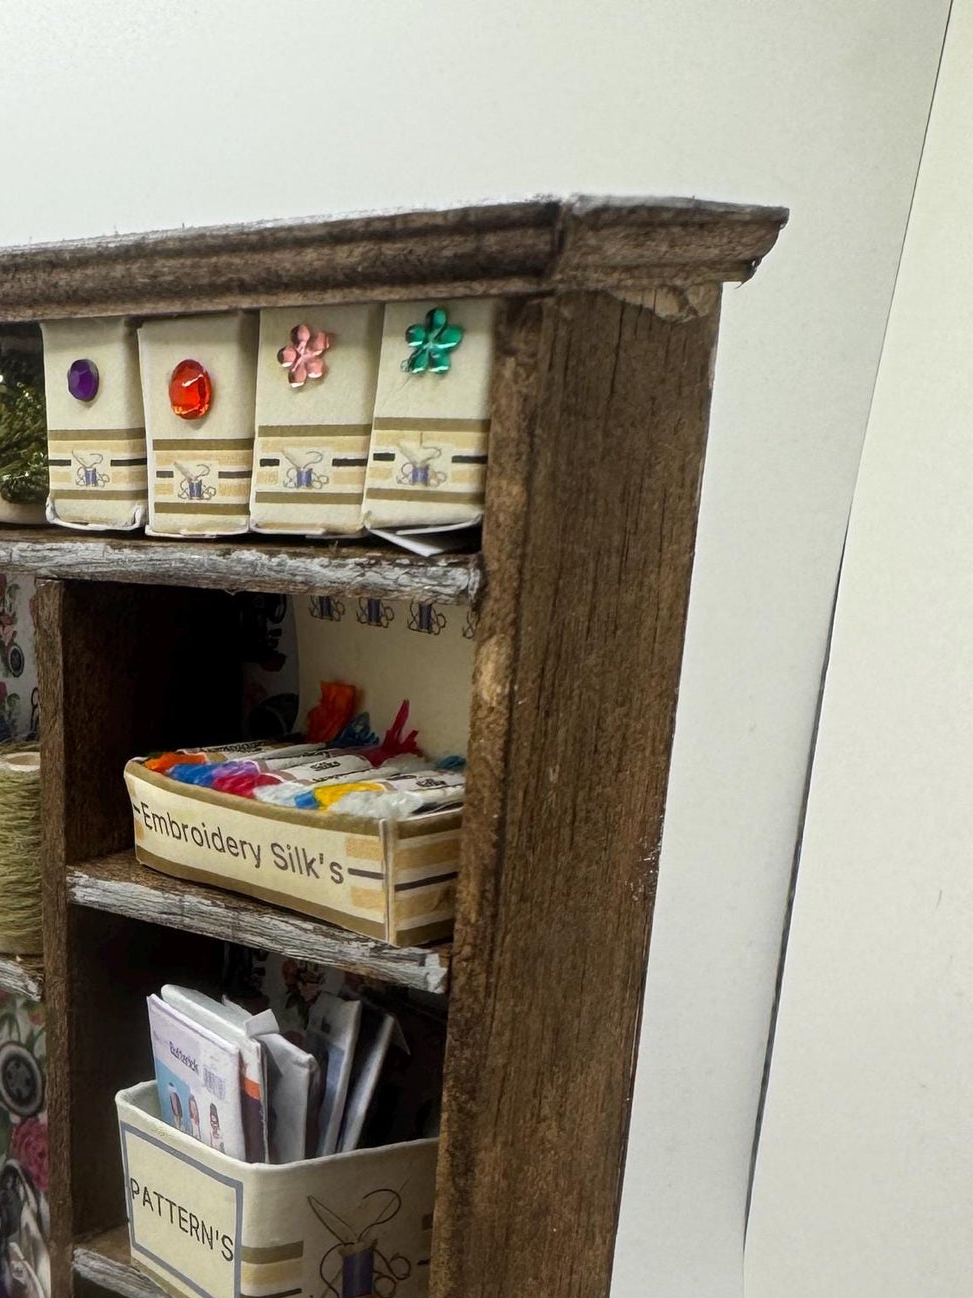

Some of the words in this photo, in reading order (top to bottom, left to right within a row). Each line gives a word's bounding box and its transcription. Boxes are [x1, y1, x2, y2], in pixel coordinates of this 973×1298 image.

[140, 802, 261, 868] Embroidery
[271, 842, 345, 885] Silk's
[130, 1177, 234, 1262] PATTERN'S
